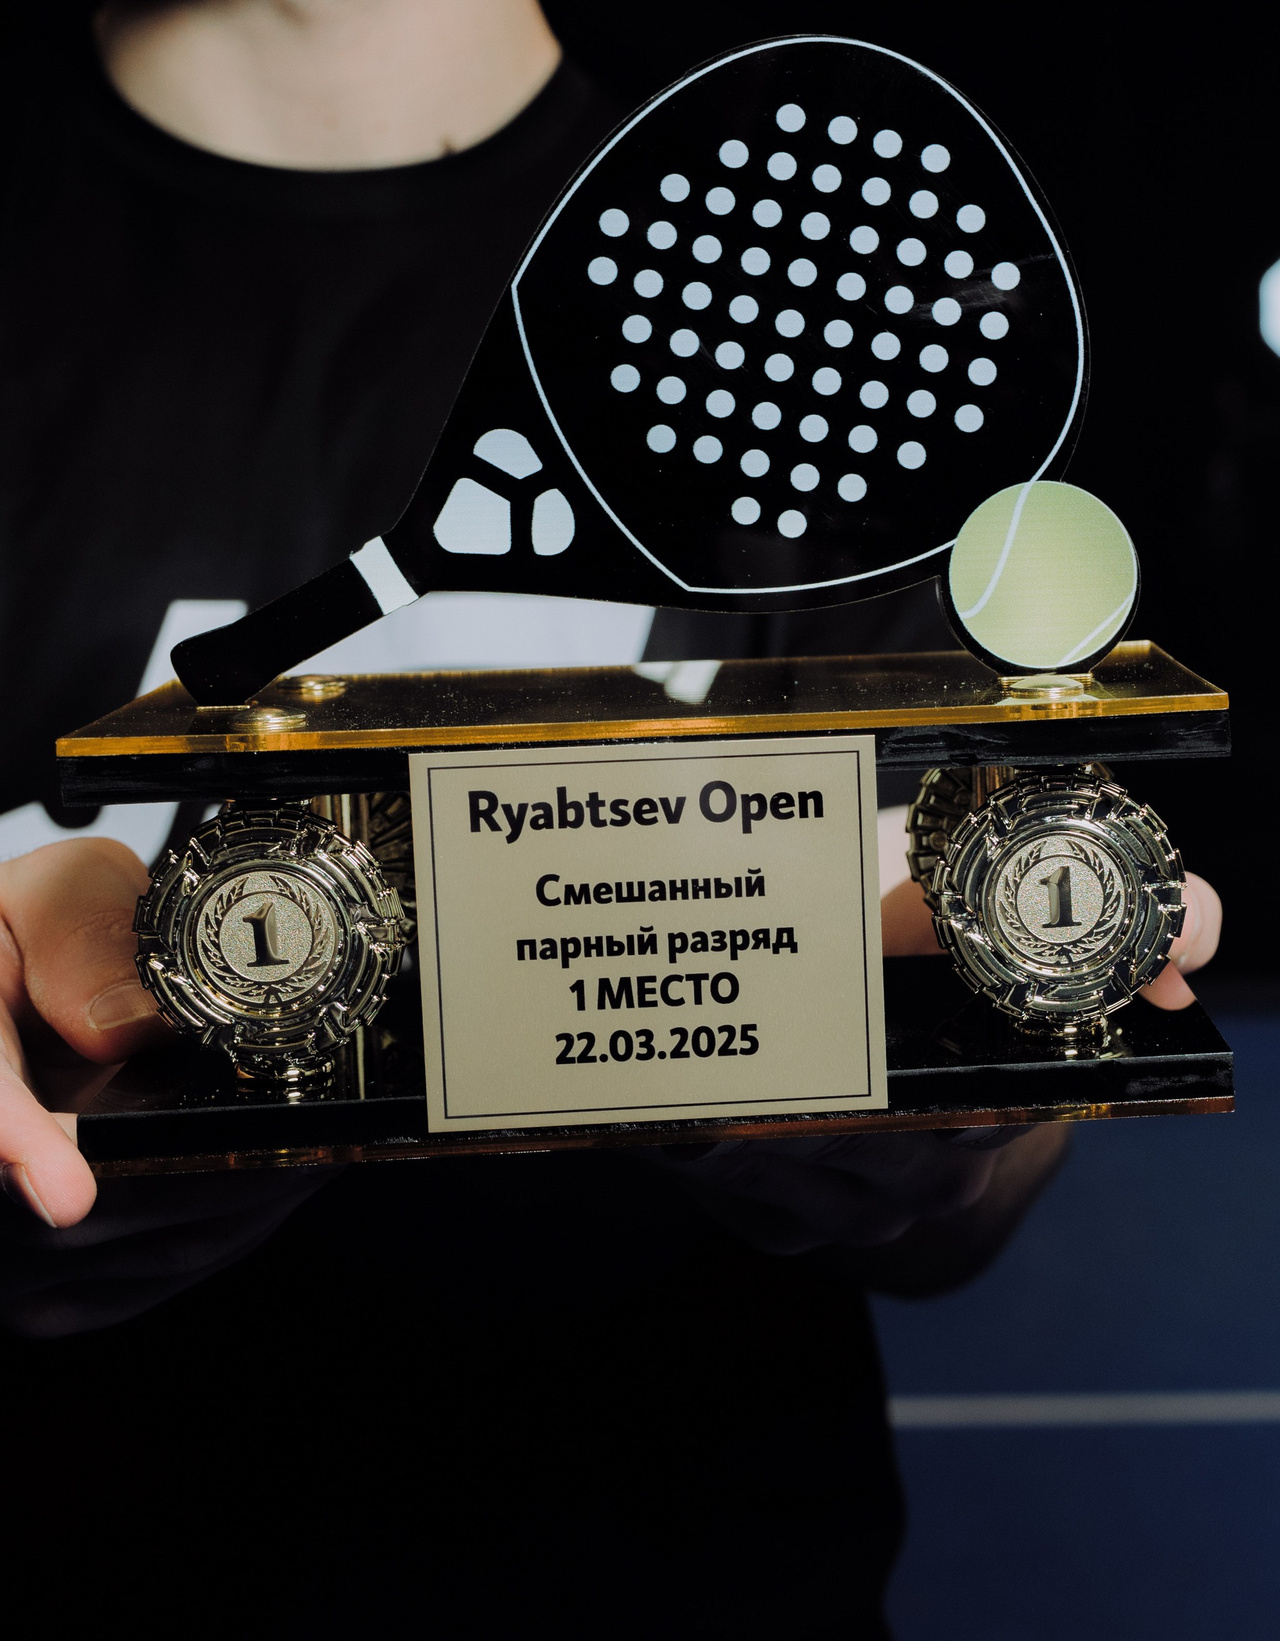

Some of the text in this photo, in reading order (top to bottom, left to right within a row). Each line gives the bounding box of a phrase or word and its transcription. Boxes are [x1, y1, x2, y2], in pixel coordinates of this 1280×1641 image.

[468, 780, 825, 845] Ryabtsev Open
[535, 867, 766, 907] Смешанный
[1039, 864, 1083, 930] 1
[242, 901, 290, 968] 1
[516, 925, 799, 968] парный разряд
[568, 971, 740, 1012] 1 МЕСТО
[555, 1023, 760, 1065] 22.03.2025
